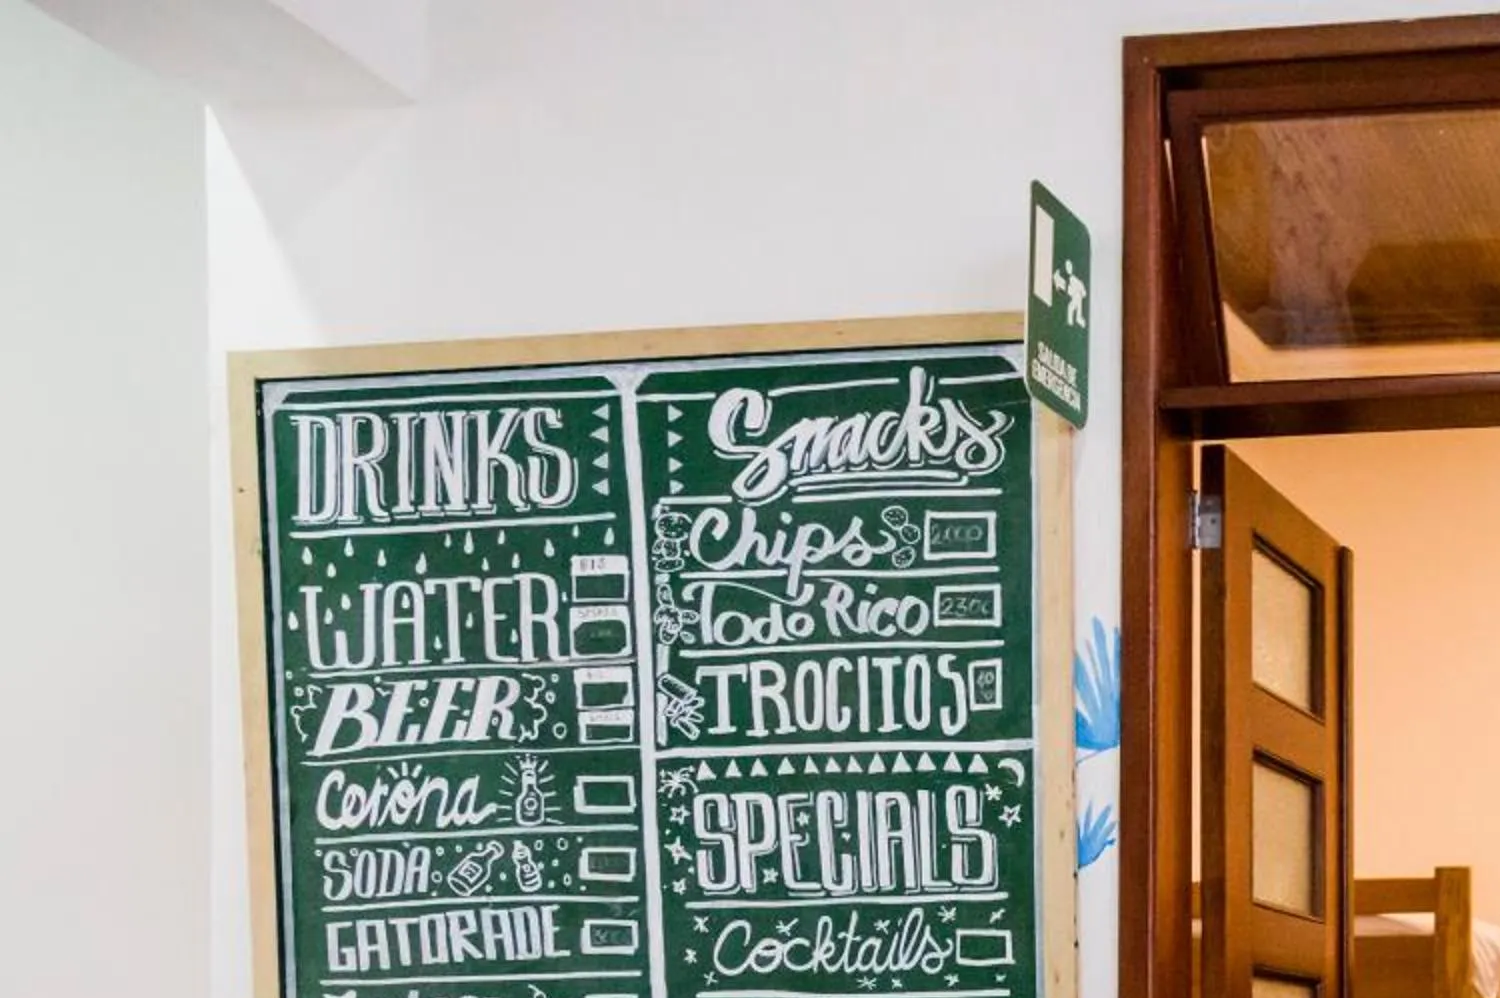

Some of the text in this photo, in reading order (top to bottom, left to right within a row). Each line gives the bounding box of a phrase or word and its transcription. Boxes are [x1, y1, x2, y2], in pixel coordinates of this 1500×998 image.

[289, 406, 579, 525] DRINKS
[707, 366, 1015, 506] Snacks
[689, 507, 900, 598] Chips
[300, 572, 570, 671] WATER
[682, 580, 814, 646] Todo
[820, 579, 930, 637] Rico
[306, 675, 521, 757] BEER
[696, 654, 968, 737] TROCITOS
[316, 766, 497, 831] Corona
[322, 846, 431, 900] SODA
[692, 785, 999, 896] SPECIALS
[326, 905, 571, 972] GATORADE
[713, 908, 953, 976] Cocktails
